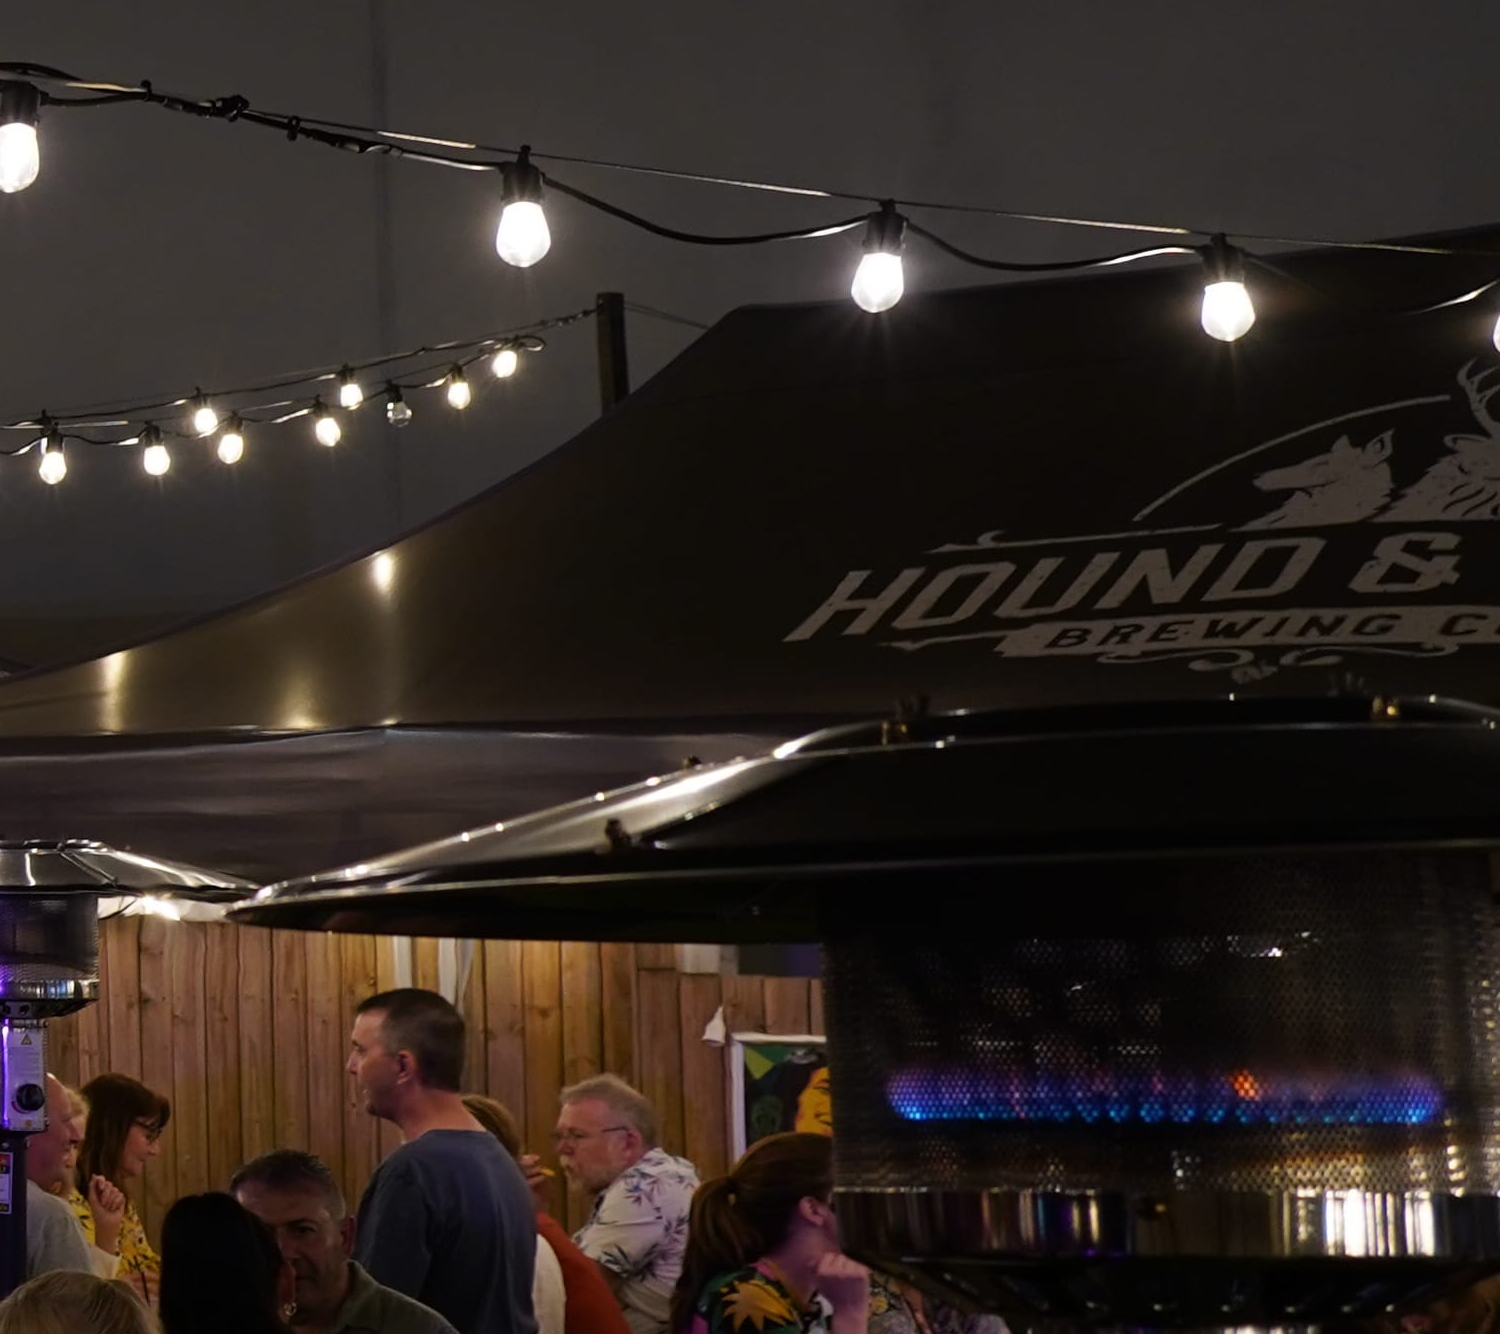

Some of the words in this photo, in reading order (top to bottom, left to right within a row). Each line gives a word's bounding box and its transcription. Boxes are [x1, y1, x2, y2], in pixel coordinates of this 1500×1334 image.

[781, 536, 1328, 643] HOUND
[1347, 531, 1463, 594] &
[1044, 615, 1402, 649] BREWING
[1440, 614, 1500, 637] C
